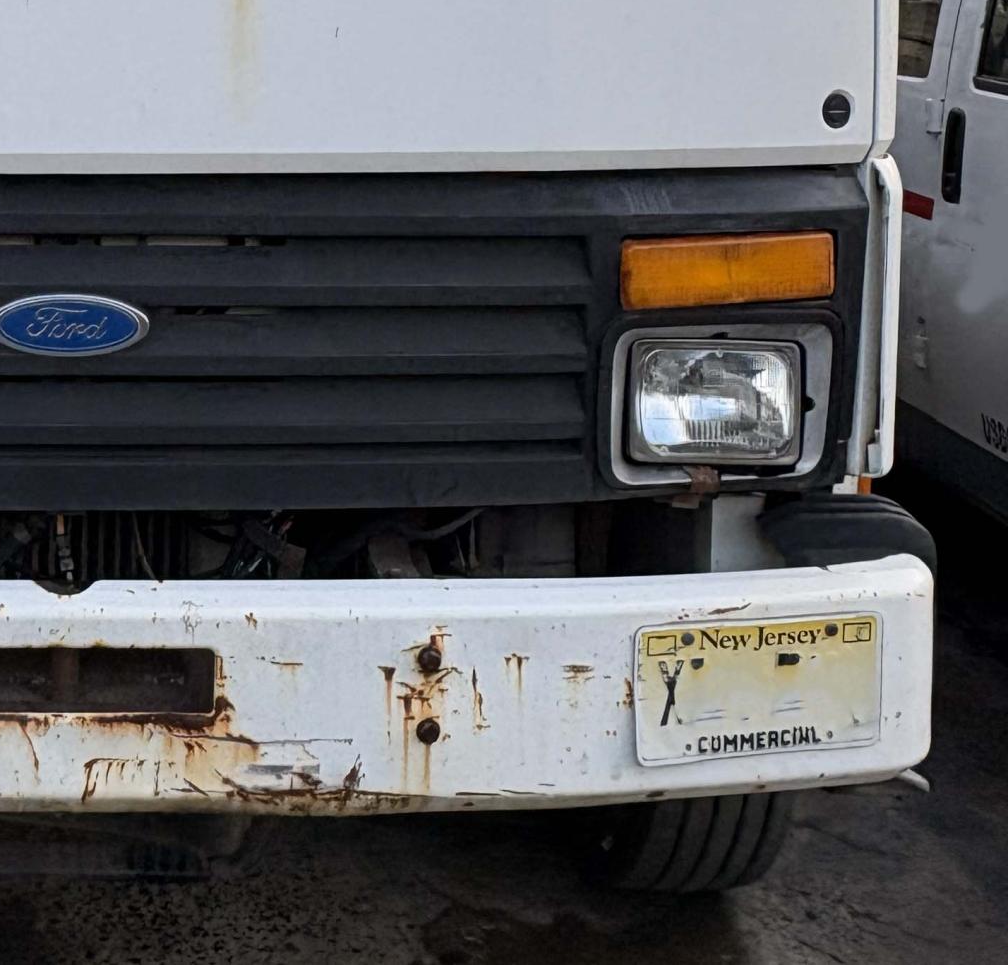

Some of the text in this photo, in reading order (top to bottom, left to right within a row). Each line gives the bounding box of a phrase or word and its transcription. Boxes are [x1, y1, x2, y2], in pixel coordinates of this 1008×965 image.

[25, 306, 107, 340] Ford
[699, 626, 822, 651] New Jersey
